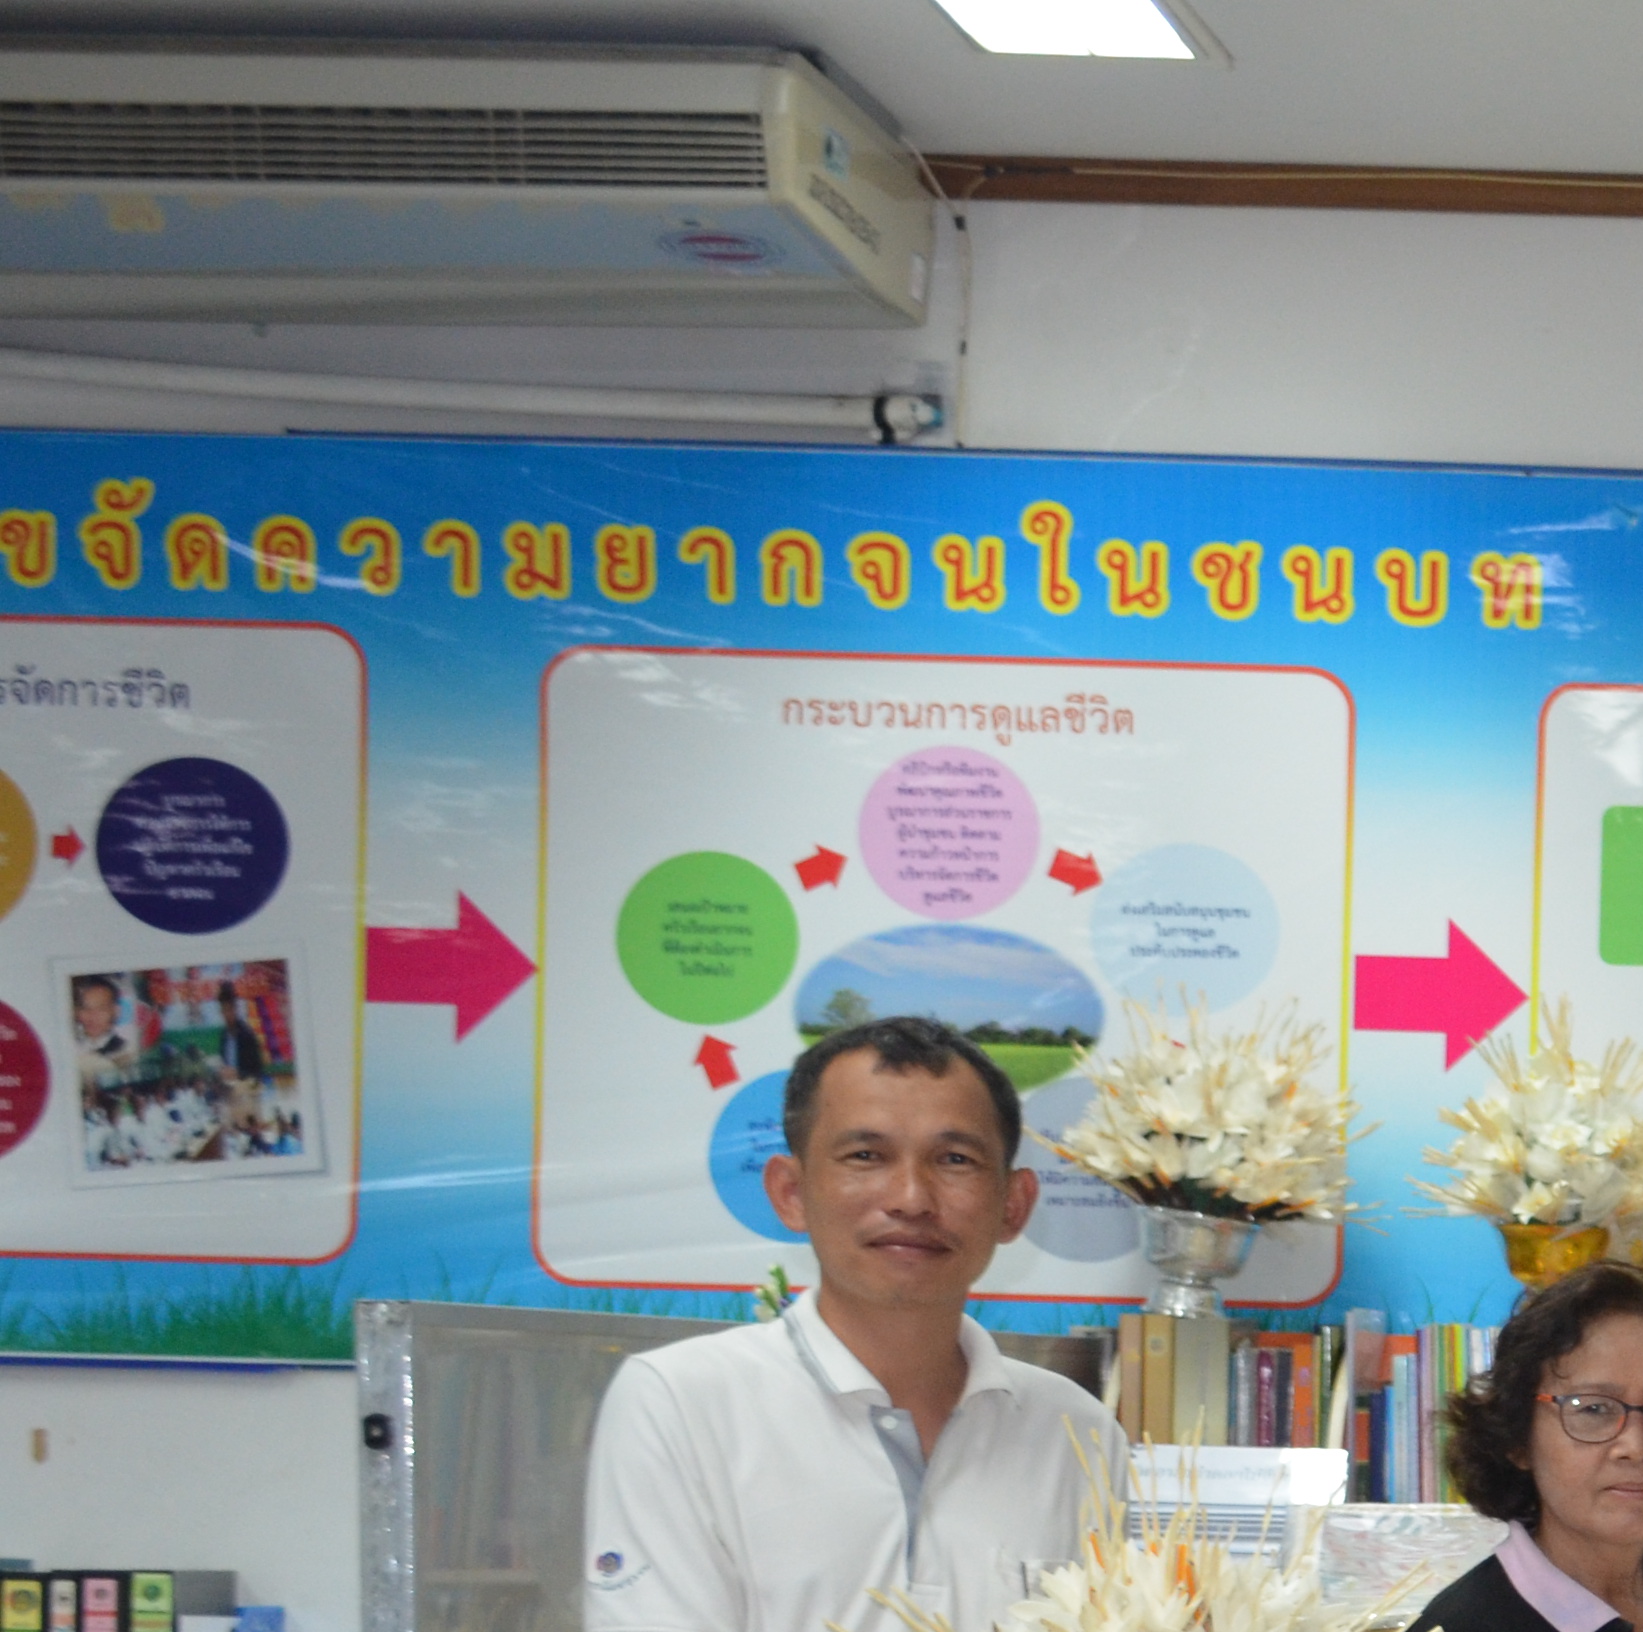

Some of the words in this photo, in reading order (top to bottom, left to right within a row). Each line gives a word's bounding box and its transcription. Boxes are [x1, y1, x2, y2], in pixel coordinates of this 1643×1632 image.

[781, 690, 1136, 747] กระบวนการดูแลชีวิต
